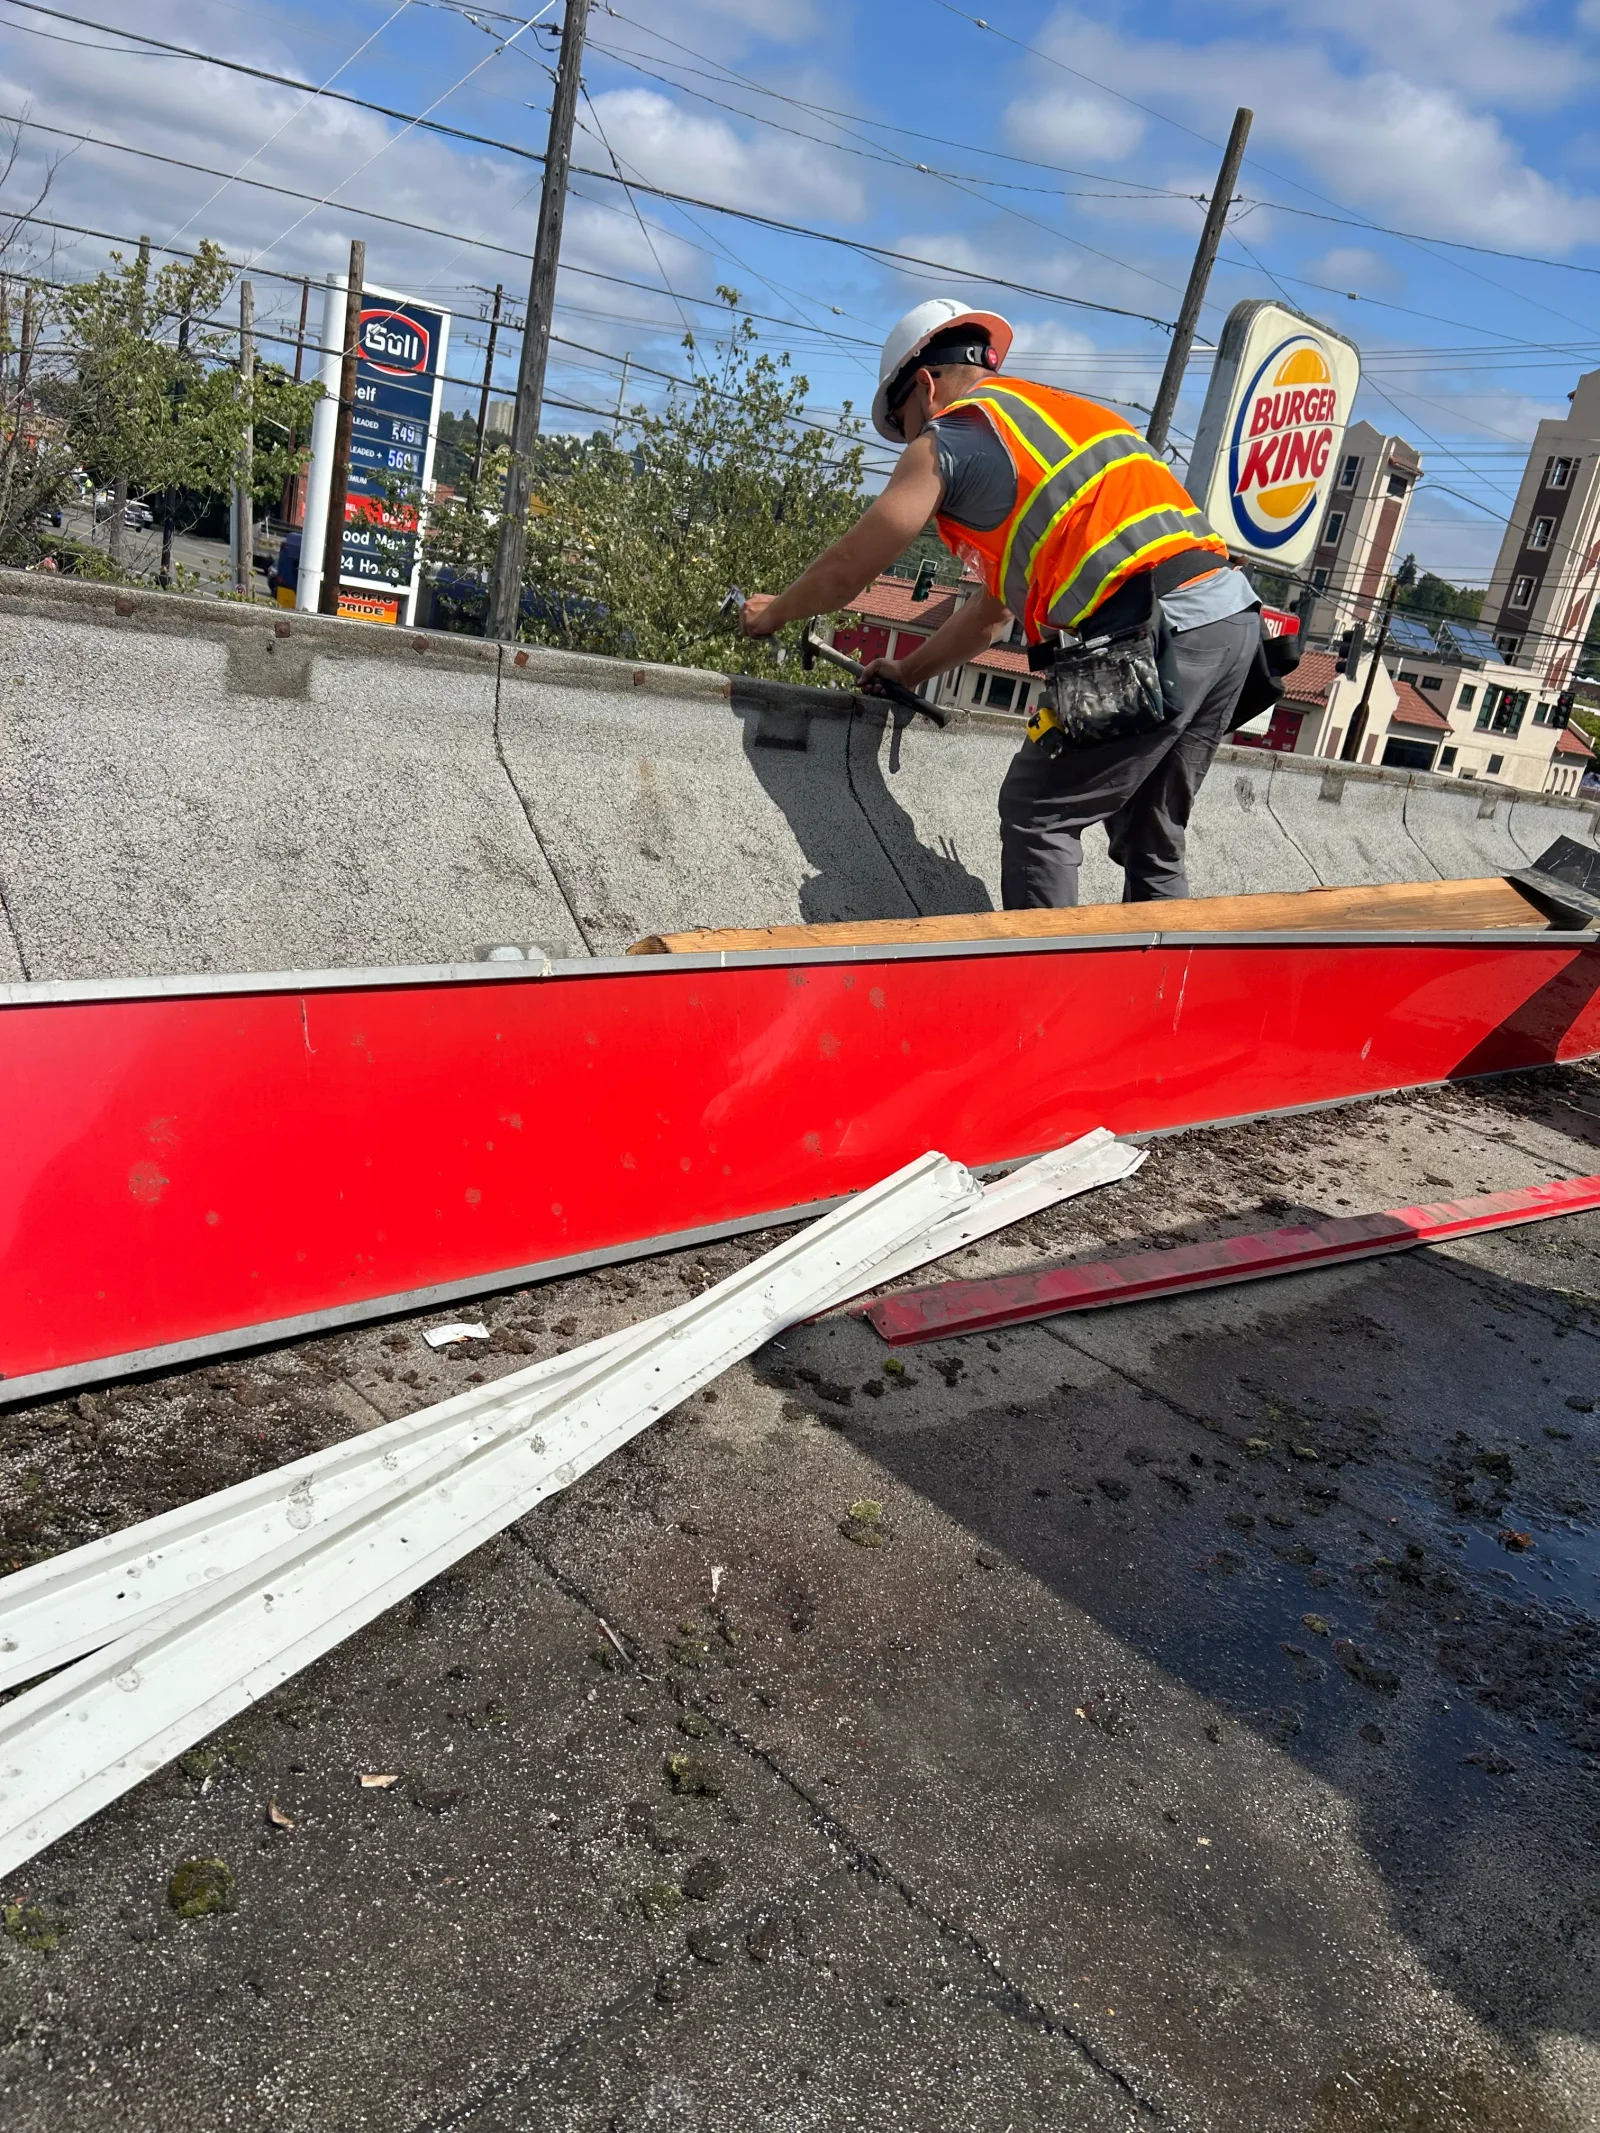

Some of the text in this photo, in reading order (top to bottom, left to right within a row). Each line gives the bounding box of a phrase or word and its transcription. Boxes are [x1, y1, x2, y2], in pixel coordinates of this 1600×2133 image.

[365, 323, 419, 361] Gull
[354, 385, 377, 402] elf
[352, 416, 379, 430] LEADED
[1249, 388, 1337, 438] BURGER
[349, 446, 375, 458] LEADED
[1237, 427, 1333, 494] KING
[342, 530, 406, 551] ood Mat
[359, 558, 400, 579] Hors
[339, 589, 395, 605] ACIFIC
